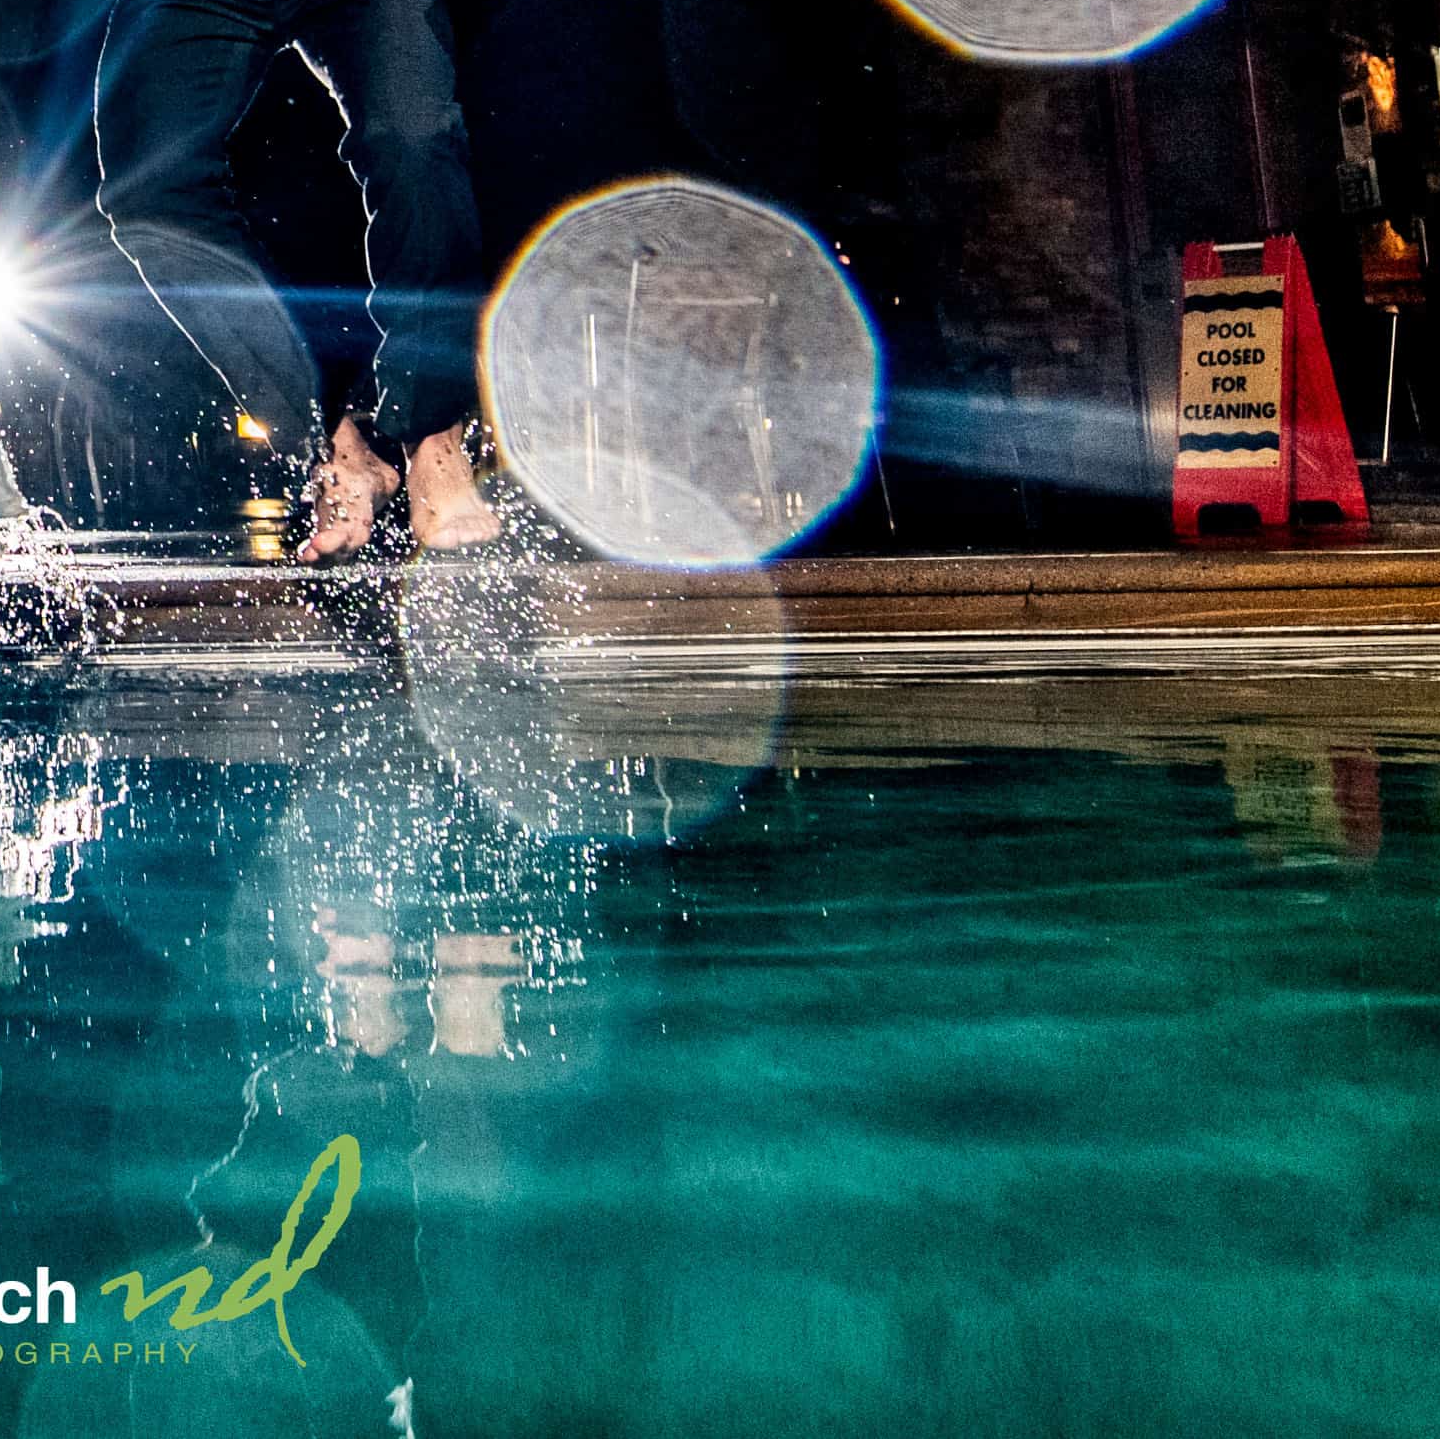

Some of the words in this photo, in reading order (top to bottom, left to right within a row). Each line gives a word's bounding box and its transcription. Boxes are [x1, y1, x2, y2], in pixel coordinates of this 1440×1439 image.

[1206, 321, 1256, 340] POOL
[1197, 348, 1266, 368] CLOSED
[1211, 375, 1248, 394] FOR
[1183, 401, 1277, 421] CLEANING
